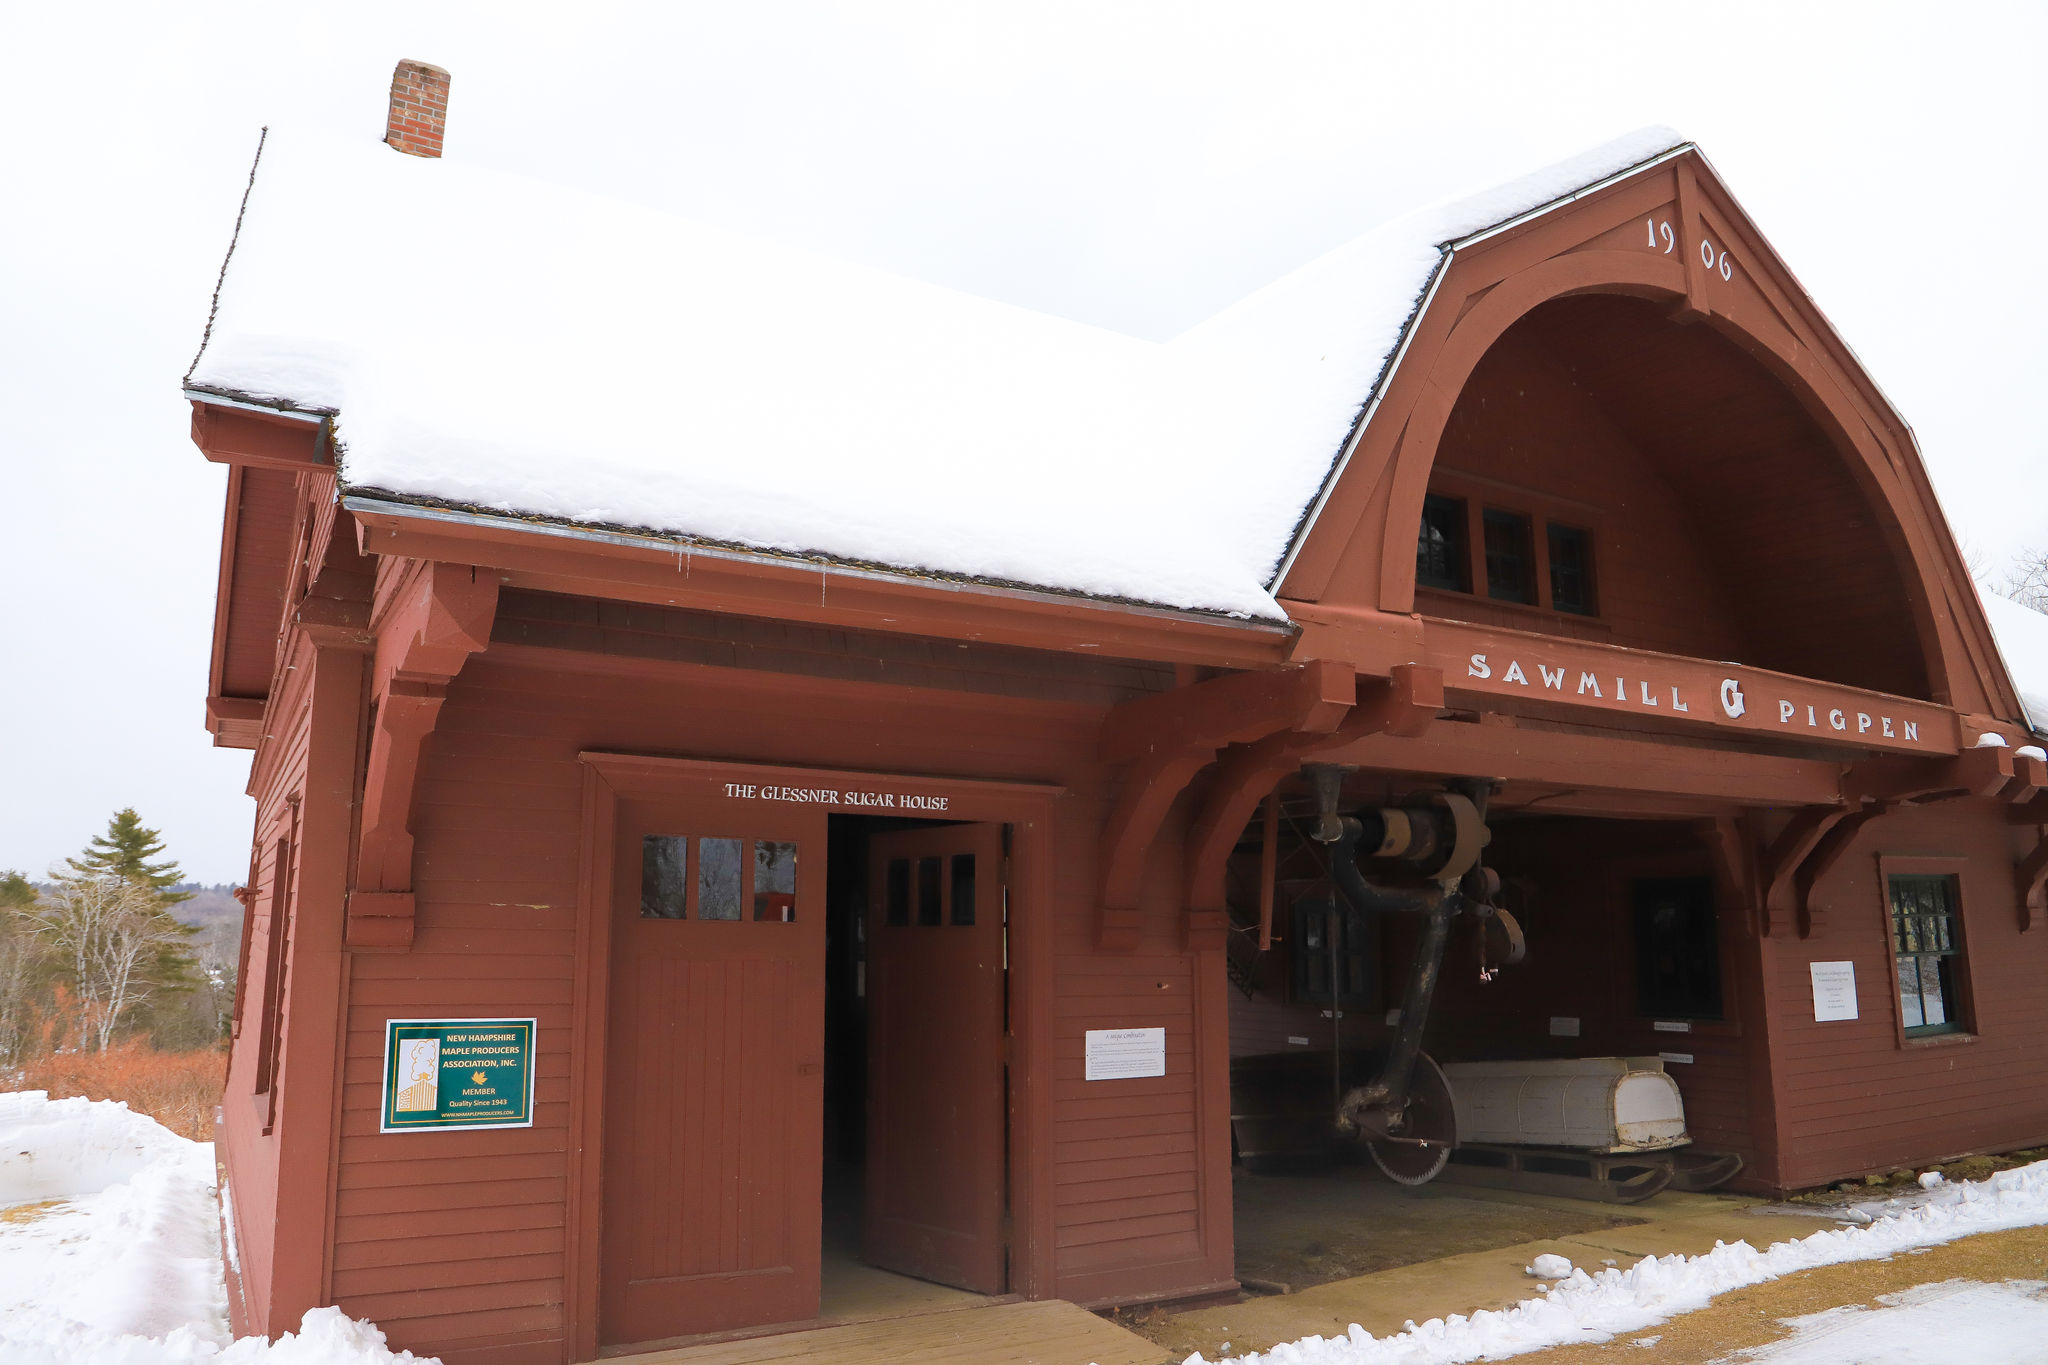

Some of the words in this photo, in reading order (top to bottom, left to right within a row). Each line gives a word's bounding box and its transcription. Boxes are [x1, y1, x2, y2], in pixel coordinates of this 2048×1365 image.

[1468, 653, 1688, 712] SAWMILL
[1720, 678, 1746, 719] G
[1779, 699, 1919, 742] PIGPEN
[725, 783, 757, 799] THE
[761, 785, 840, 805] GLESSNER
[844, 791, 895, 808] SUGAR
[900, 795, 949, 811] HOUSE
[446, 1034, 467, 1042] NEW
[468, 1034, 516, 1042] HAMPSHIRE
[472, 1047, 519, 1055] PRODUCERS
[442, 1060, 499, 1068] ASSOCIATION,
[500, 1059, 517, 1067] INC.
[462, 1088, 496, 1096] MEMBER
[449, 1100, 473, 1108] Quality
